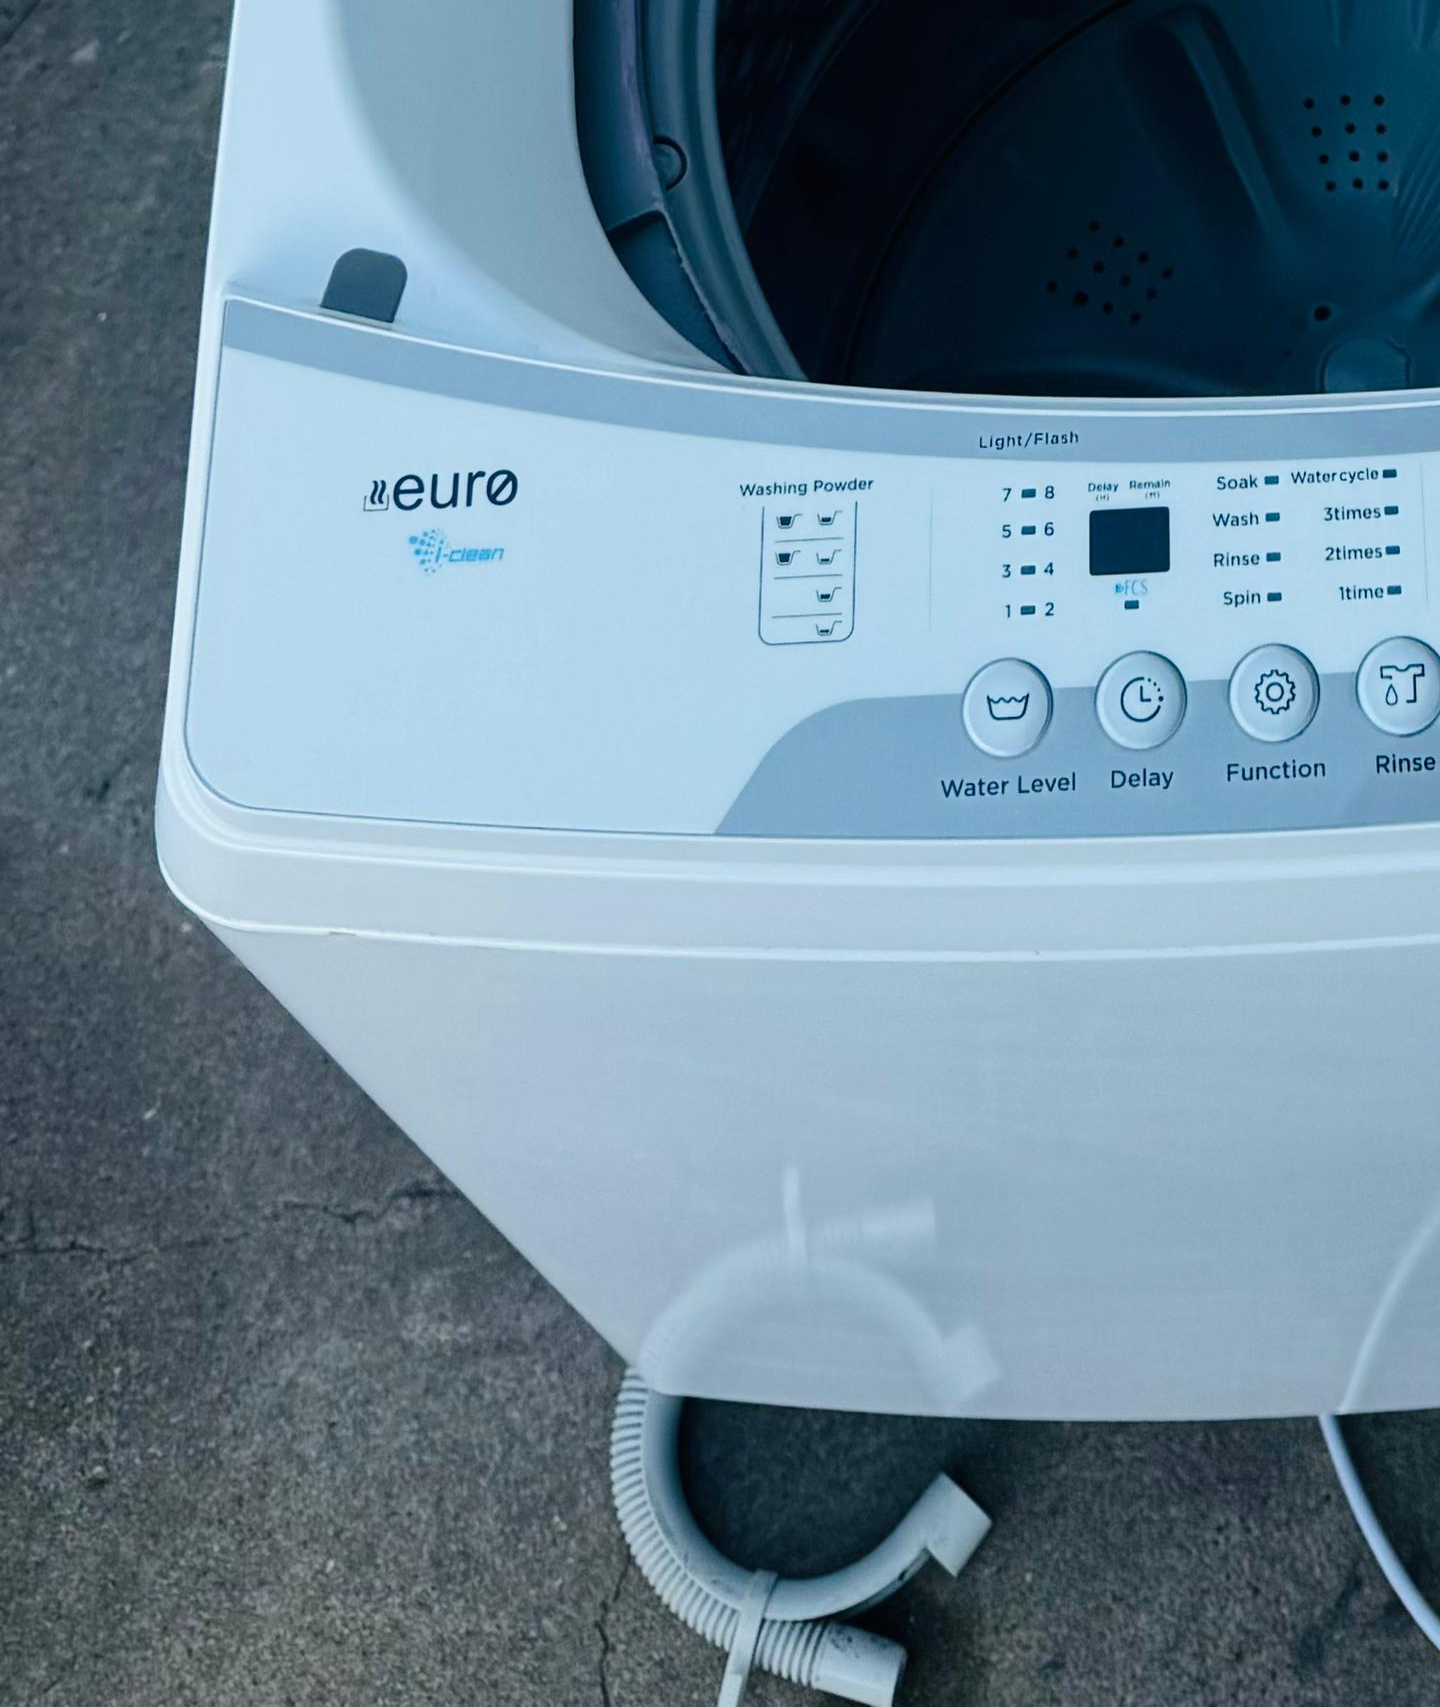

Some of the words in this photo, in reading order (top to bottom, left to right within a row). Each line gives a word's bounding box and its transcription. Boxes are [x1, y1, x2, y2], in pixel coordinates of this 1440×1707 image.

[979, 430, 1080, 451] Light/Flash
[739, 481, 808, 497] Washing
[813, 477, 874, 492] Powder
[1087, 482, 1119, 493] Delay
[1129, 479, 1171, 490] Remain
[1216, 475, 1259, 491] Soak
[1001, 487, 1013, 503] 7
[1044, 485, 1056, 501] 8
[1213, 512, 1260, 528] Wash
[1324, 505, 1382, 522] 3times
[1001, 524, 1012, 539] 5
[1044, 522, 1055, 537] 6
[1213, 552, 1260, 568] Rinse
[1325, 545, 1383, 562] 2times
[1001, 563, 1011, 578] 3
[1043, 562, 1054, 577] 4
[1223, 590, 1261, 608] Spin
[1339, 584, 1384, 601] 1time
[1004, 604, 1012, 619] 1
[1044, 602, 1055, 617] 2
[1225, 758, 1327, 783] Function
[1376, 752, 1437, 775] Rinse
[940, 777, 1010, 799] Water
[1017, 771, 1076, 795] Level
[1110, 767, 1175, 790] Delay
